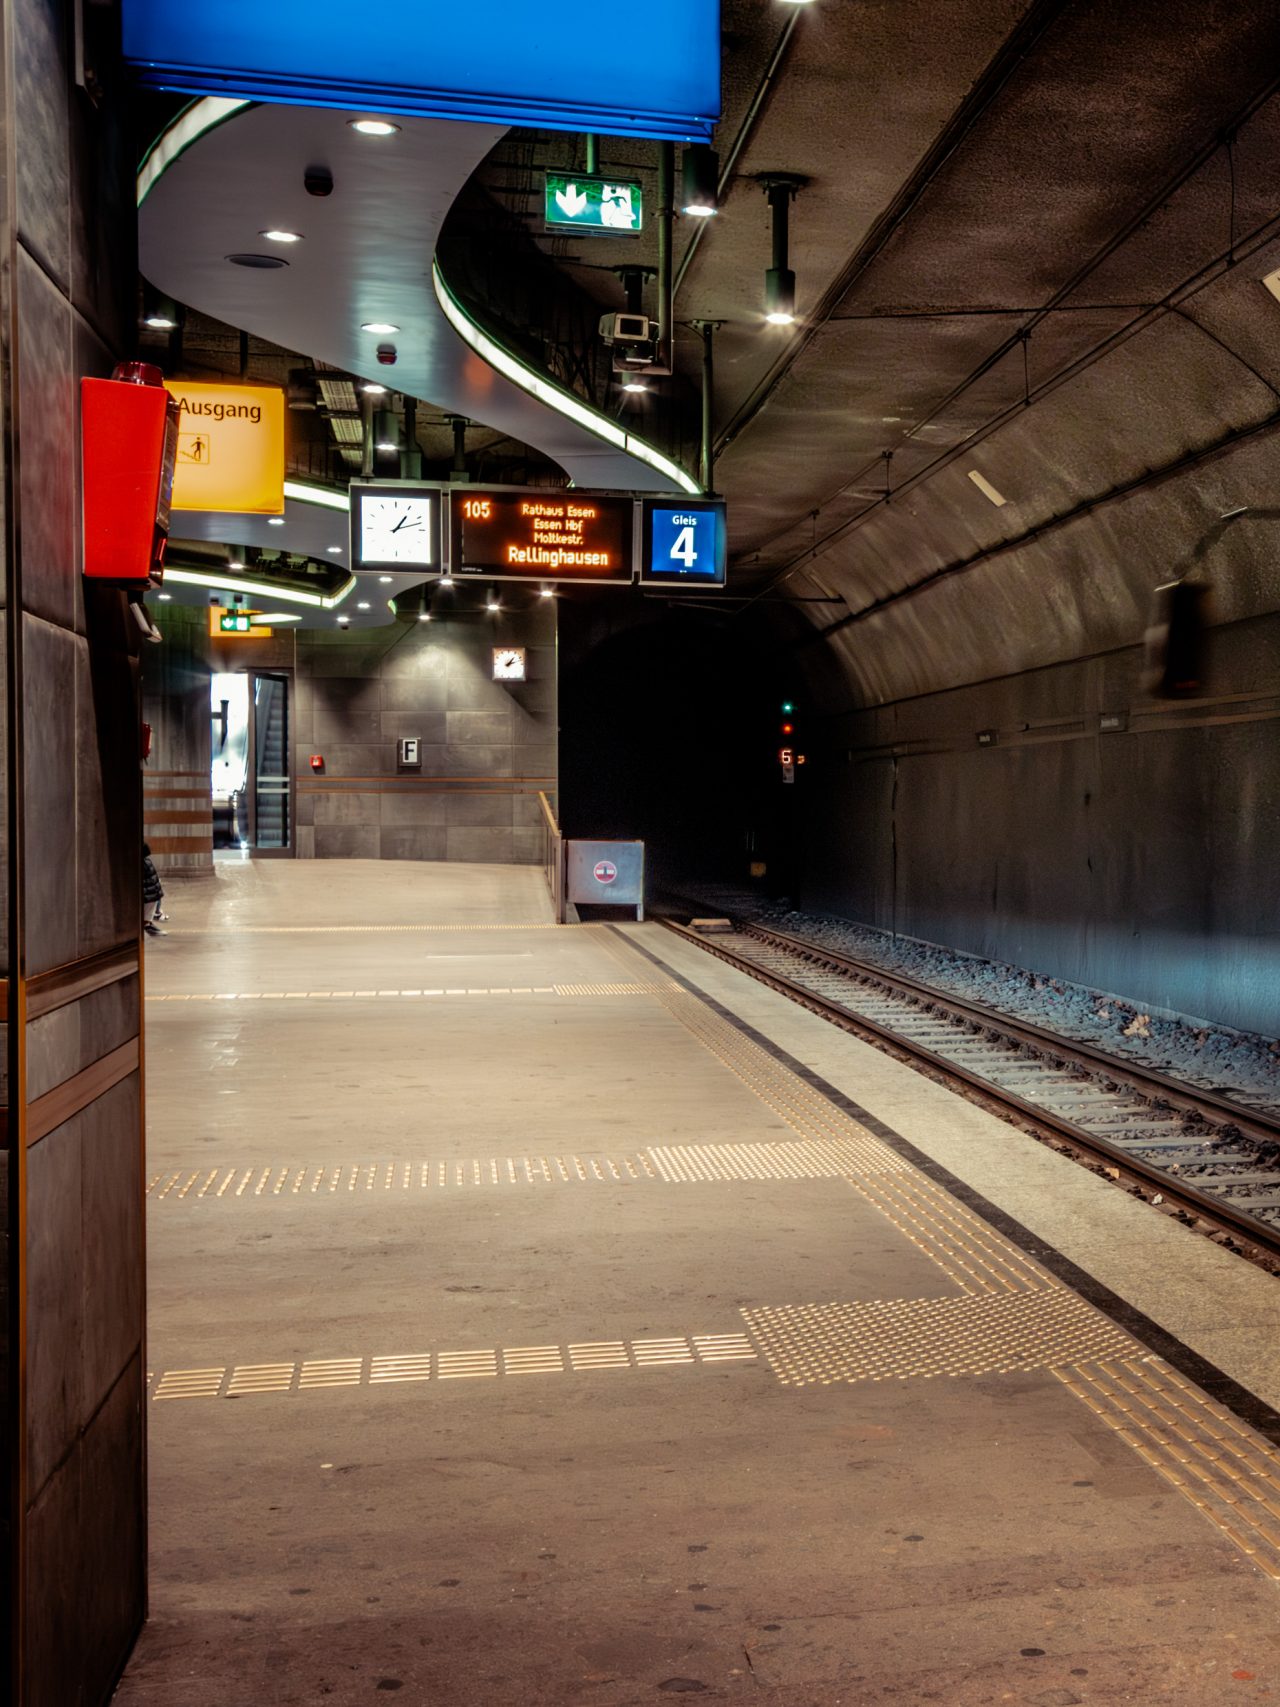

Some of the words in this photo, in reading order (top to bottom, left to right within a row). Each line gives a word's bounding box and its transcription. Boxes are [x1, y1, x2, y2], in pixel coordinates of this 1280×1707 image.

[179, 398, 261, 423] Ausgang
[464, 501, 490, 518] 105
[522, 503, 564, 517] Rathaus
[567, 505, 595, 518] Essen
[534, 518, 562, 530] Essen
[565, 519, 583, 533] Hbf
[672, 514, 697, 526] Gleis
[534, 532, 584, 545] Moltkestr.
[670, 527, 698, 567] 4
[508, 546, 608, 568] Rellinghausen
[405, 741, 415, 760] F
